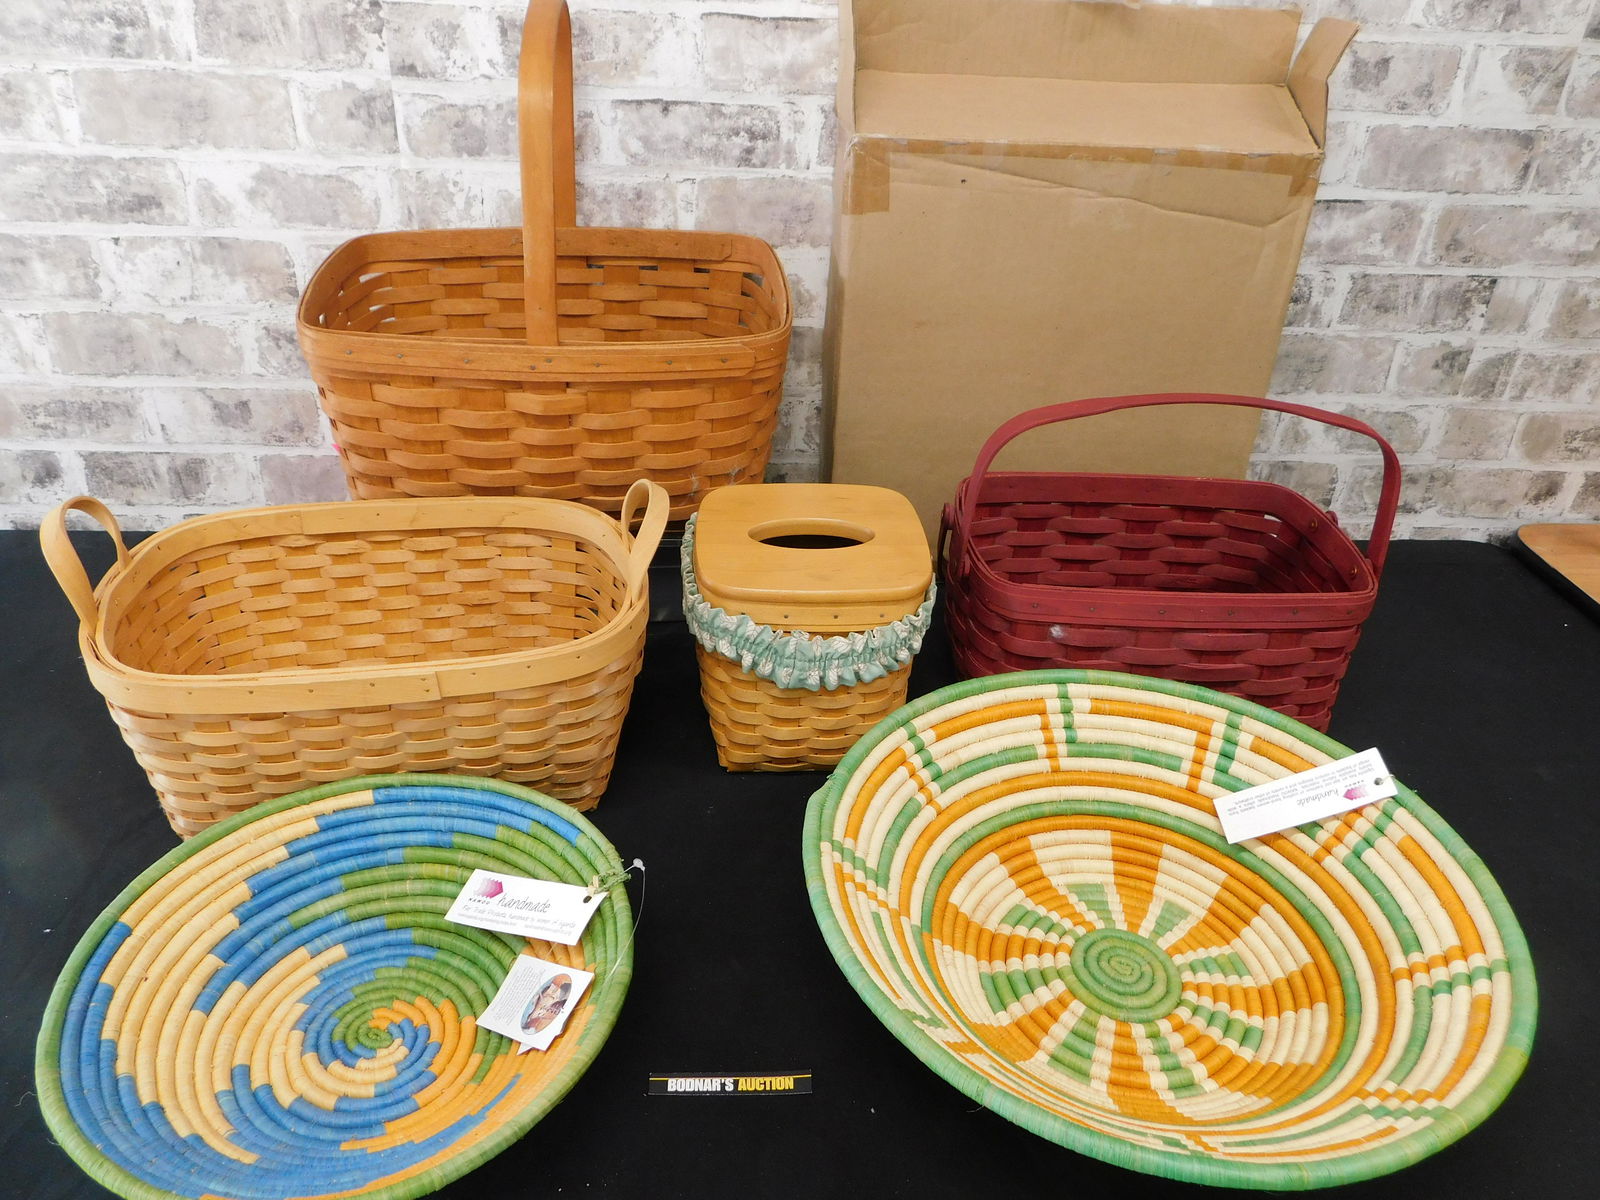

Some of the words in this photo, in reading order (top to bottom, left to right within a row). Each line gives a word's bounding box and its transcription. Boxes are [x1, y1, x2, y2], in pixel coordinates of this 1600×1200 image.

[1296, 788, 1339, 807] handmade
[497, 893, 551, 913] handmade
[667, 1078, 734, 1092] BODNAR'S
[737, 1077, 794, 1091] AUCTION
